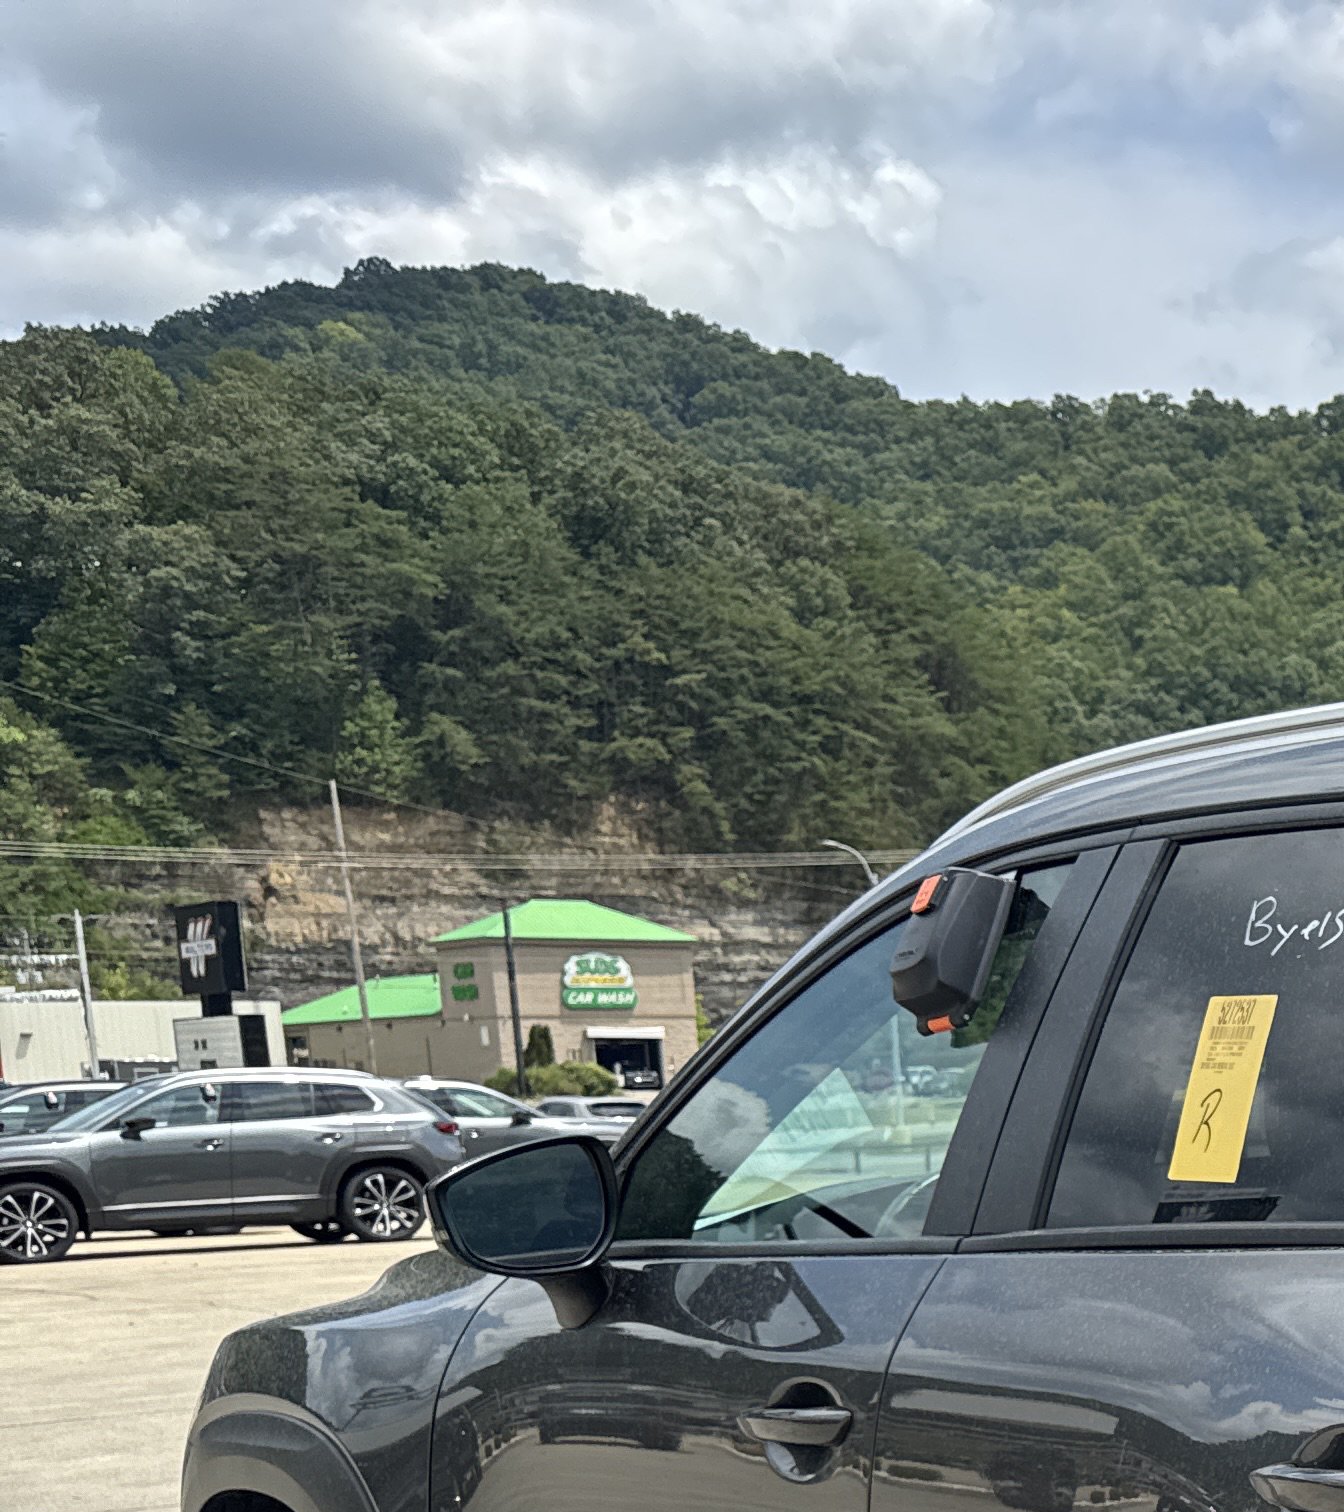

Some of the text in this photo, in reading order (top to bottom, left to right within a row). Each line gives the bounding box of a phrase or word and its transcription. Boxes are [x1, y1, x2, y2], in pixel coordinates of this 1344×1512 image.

[567, 990, 636, 1005] CAR WASH
[1191, 1087, 1223, 1154] R
